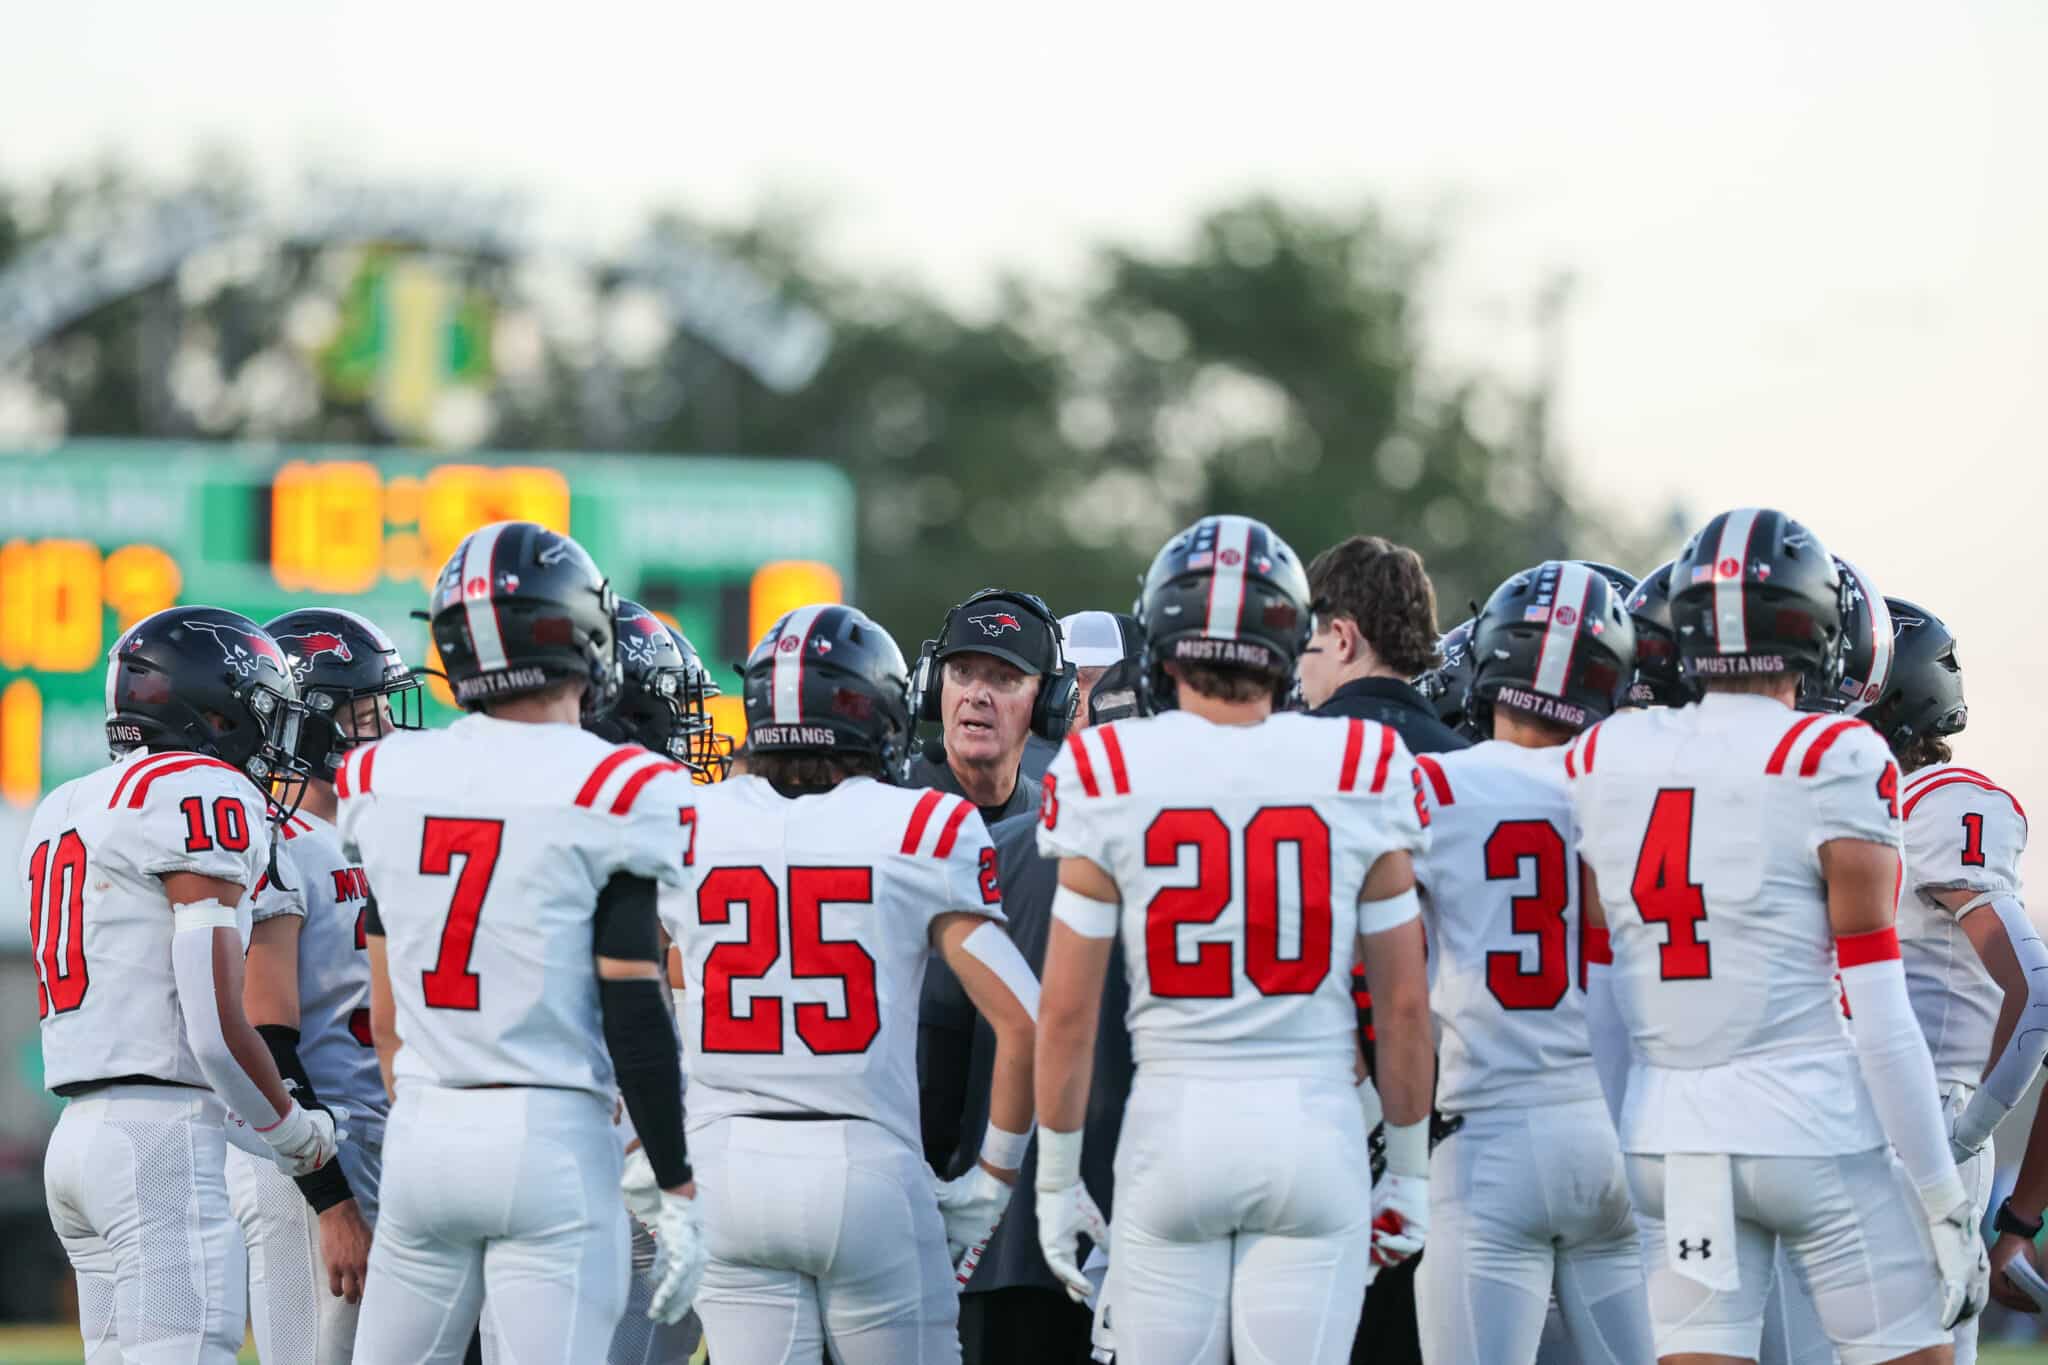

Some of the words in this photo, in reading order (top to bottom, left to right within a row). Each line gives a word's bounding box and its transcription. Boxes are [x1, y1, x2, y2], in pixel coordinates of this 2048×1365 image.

[457, 667, 547, 696] MUSTANGS
[1176, 640, 1269, 667] MUSTANGS
[1696, 655, 1785, 673] MUSTANGS
[106, 725, 142, 742] TANGS
[1498, 686, 1586, 725] MUSTANGS
[754, 726, 836, 745] MUSTANGS
[180, 796, 250, 853] 10
[1411, 767, 1431, 828] 2
[1961, 813, 1985, 867] 1
[978, 847, 1002, 905] 2
[1144, 805, 1332, 999] 20
[1630, 787, 1713, 981] 4
[28, 828, 89, 1021] 10
[419, 816, 505, 1011] 7
[1484, 819, 1589, 1011] 3
[697, 865, 881, 1055] 25
